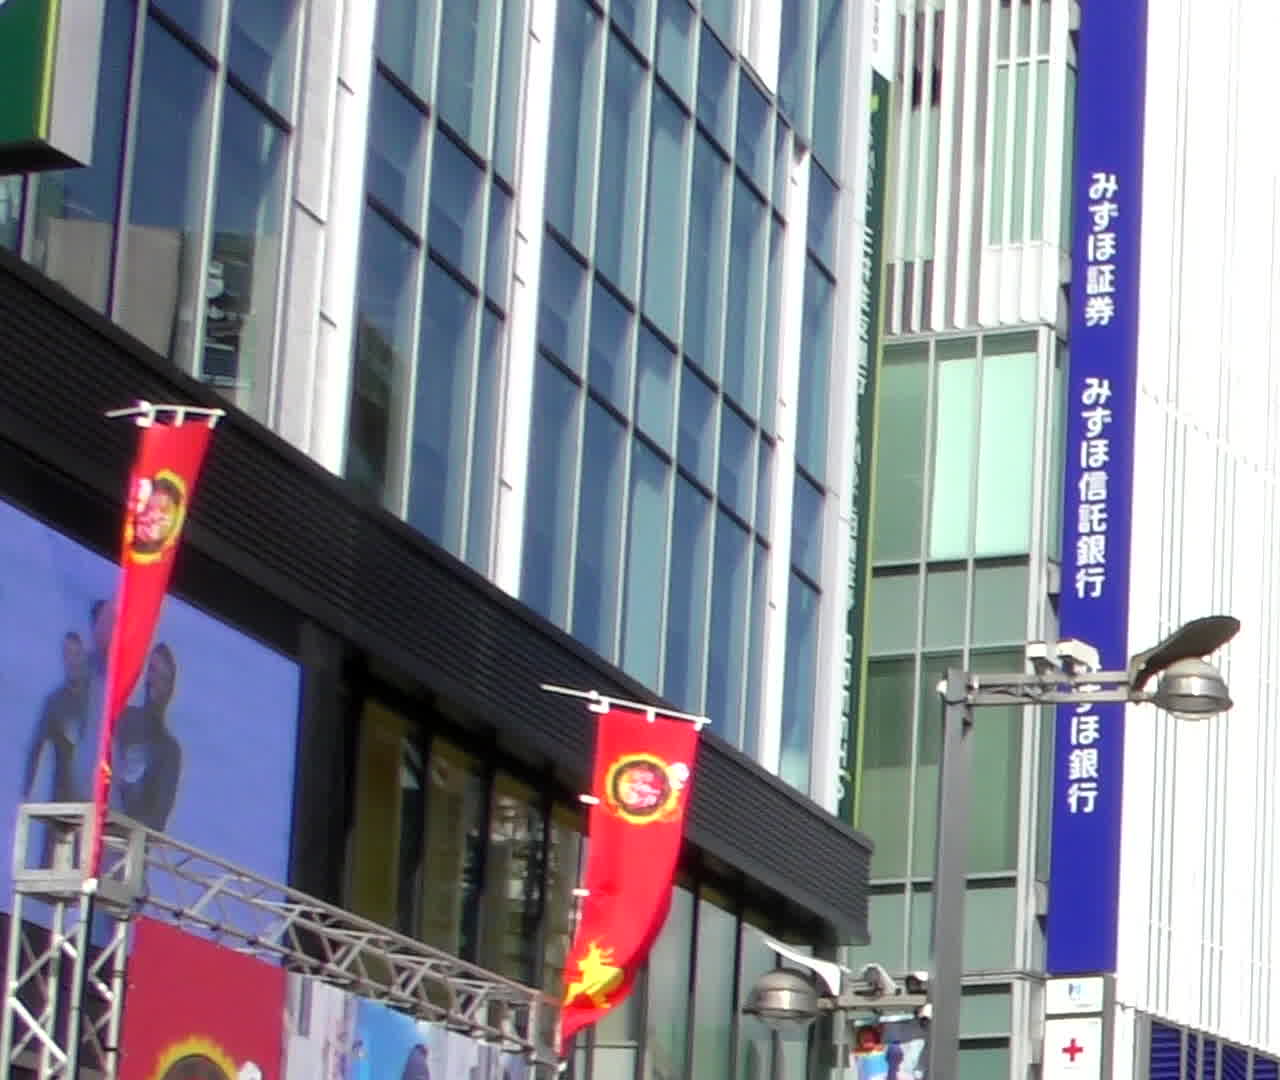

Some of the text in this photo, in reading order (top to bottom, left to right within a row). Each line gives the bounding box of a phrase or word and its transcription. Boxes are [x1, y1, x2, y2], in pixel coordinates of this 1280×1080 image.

[1085, 172, 1119, 326] みずほ証券
[1075, 378, 1112, 598] みずほ信託銀行
[1067, 680, 1101, 814] ほ銀行
